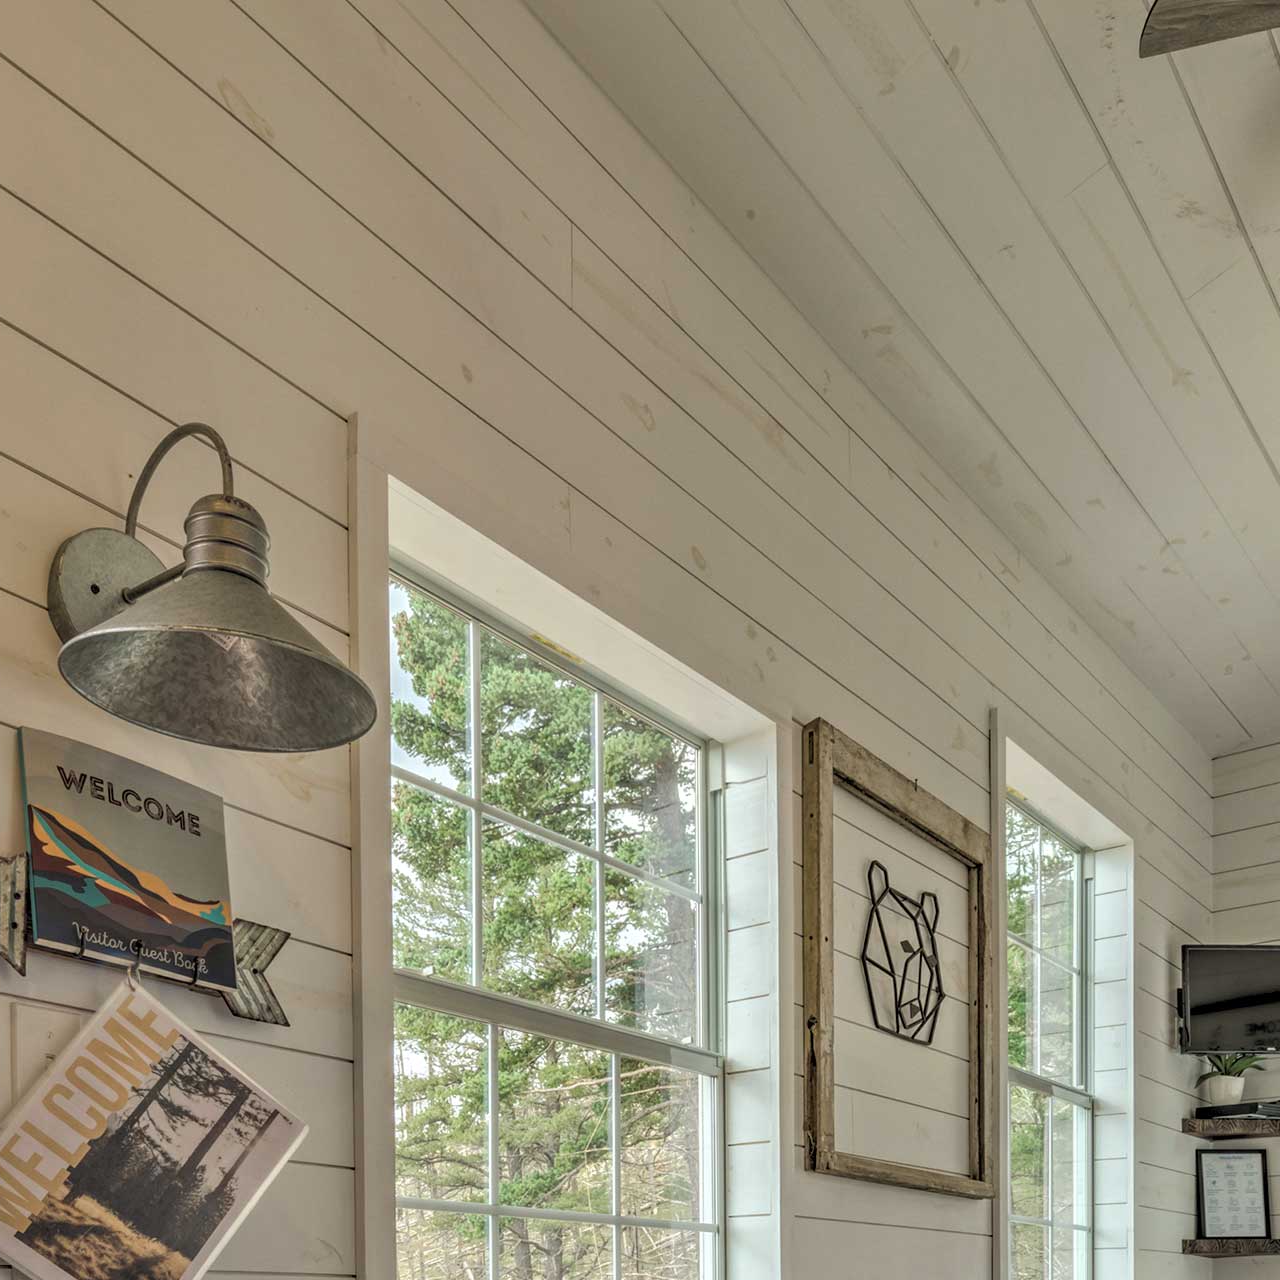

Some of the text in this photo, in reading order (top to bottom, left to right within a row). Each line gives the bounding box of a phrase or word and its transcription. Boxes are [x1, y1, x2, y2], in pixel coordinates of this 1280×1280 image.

[56, 765, 201, 837] WELCOME
[71, 921, 127, 951] Visitor
[129, 938, 172, 963] Guest
